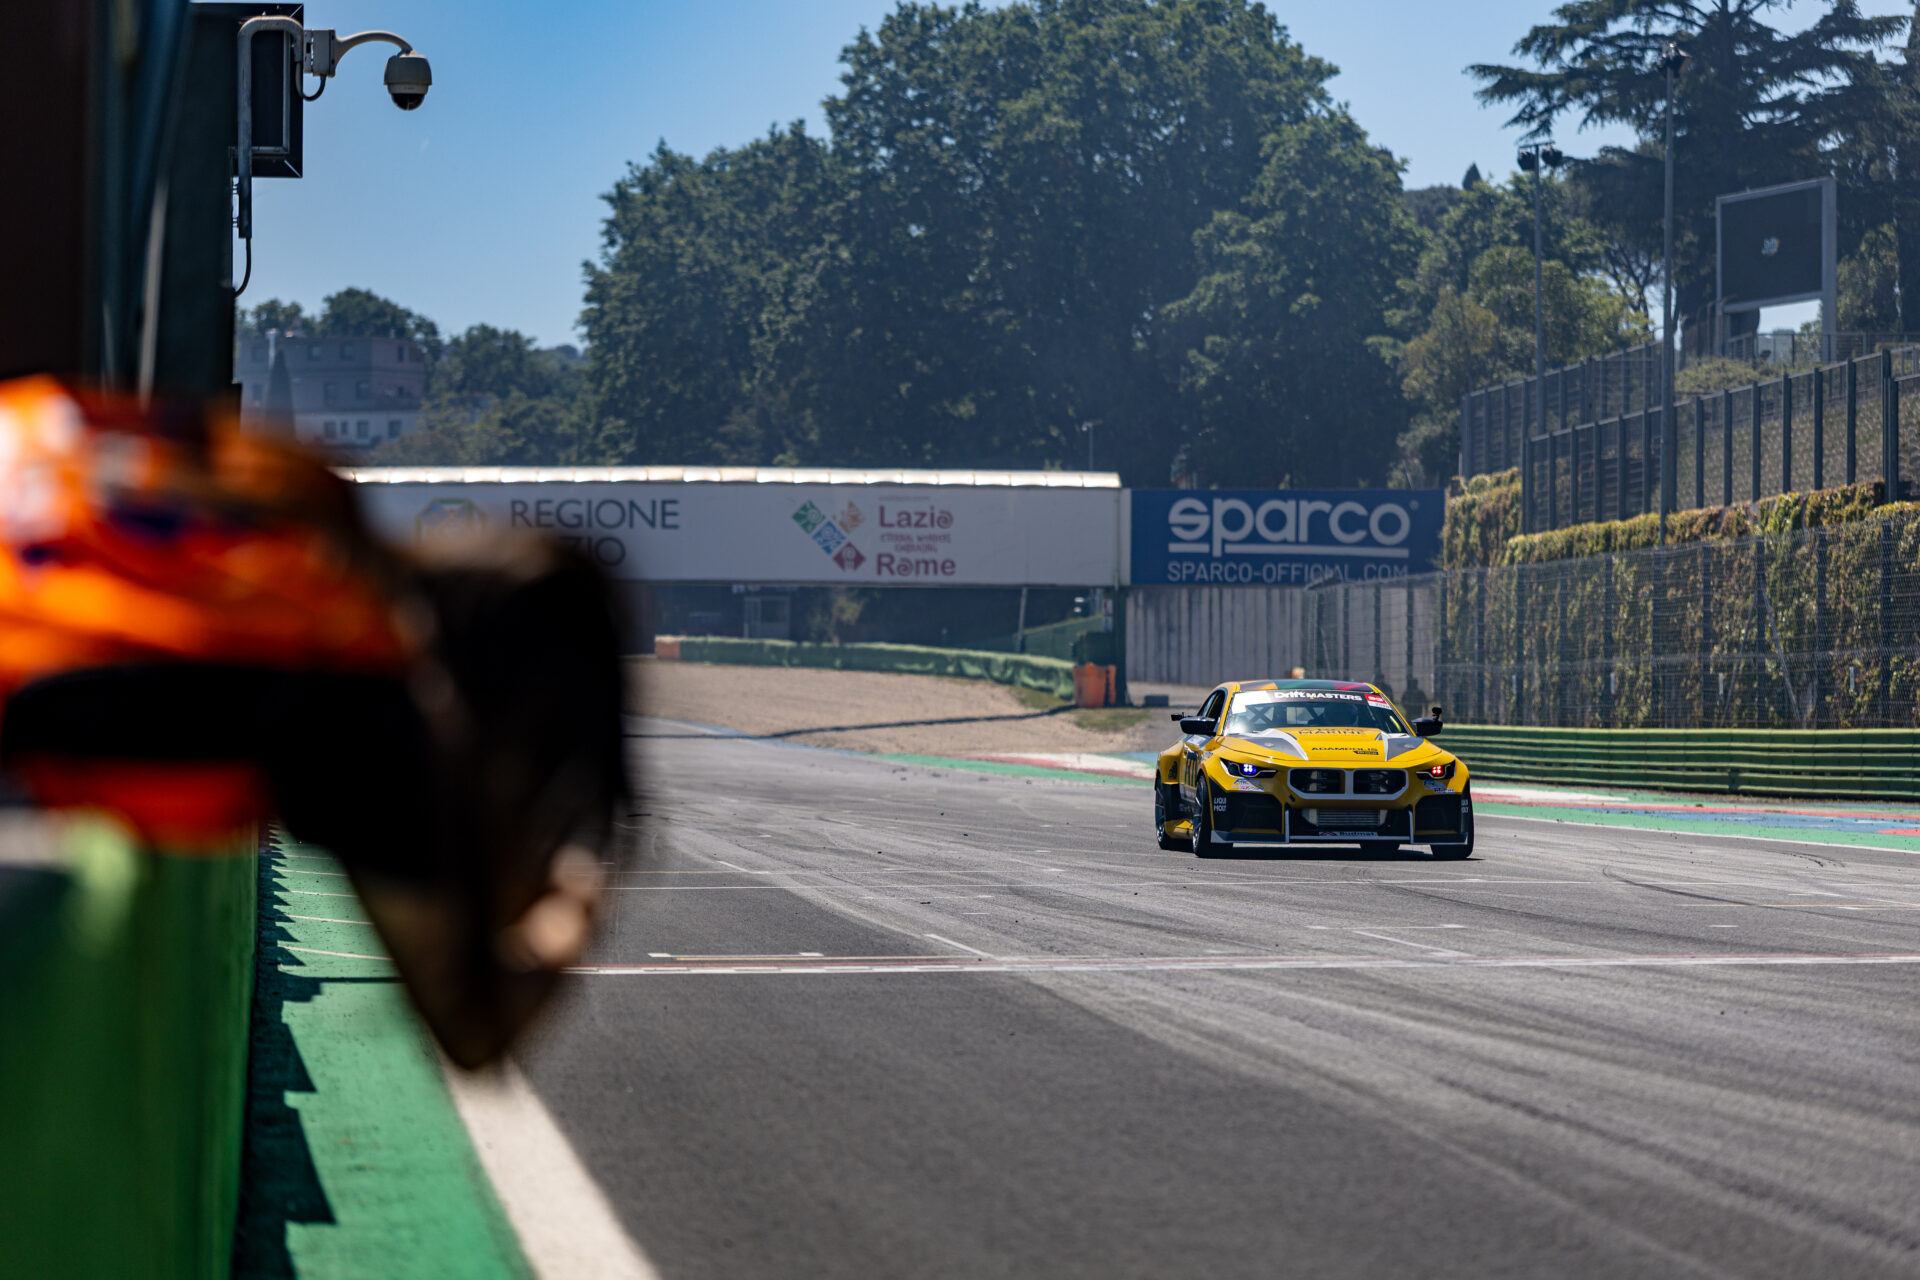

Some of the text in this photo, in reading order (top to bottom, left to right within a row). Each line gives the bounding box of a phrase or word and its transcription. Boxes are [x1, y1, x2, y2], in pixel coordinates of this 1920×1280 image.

[511, 499, 680, 530] REGIONE
[878, 505, 954, 529] Lazio
[1168, 497, 1411, 557] sparco
[876, 553, 956, 577] Rome
[1306, 692, 1363, 701] MASTERS
